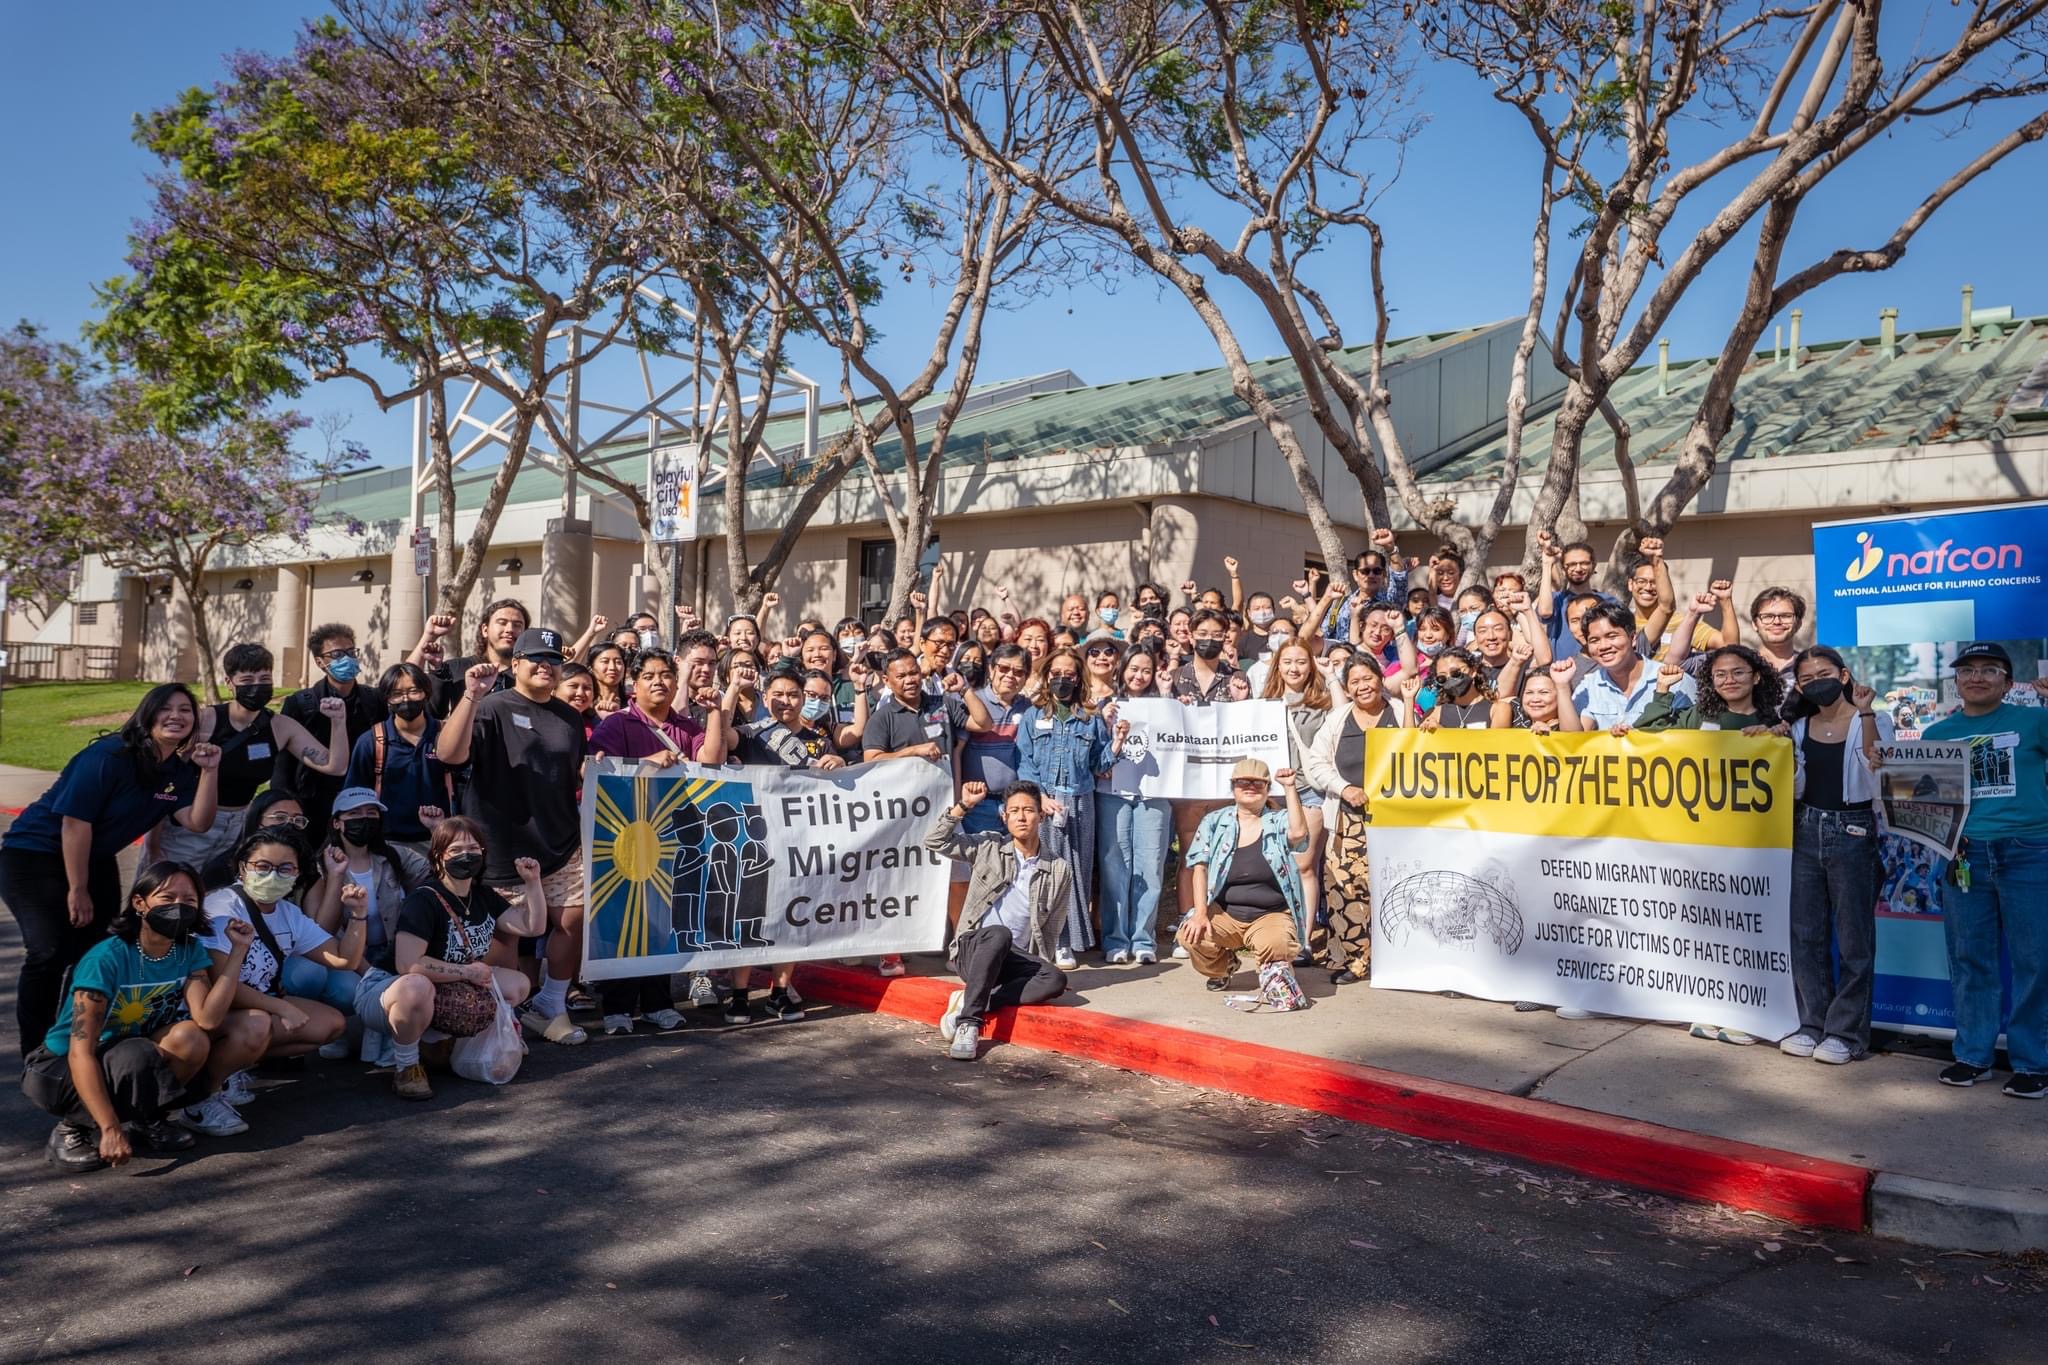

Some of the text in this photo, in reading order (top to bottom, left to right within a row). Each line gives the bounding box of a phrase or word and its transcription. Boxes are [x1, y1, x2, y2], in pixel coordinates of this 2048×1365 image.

[655, 466, 694, 487] playful
[656, 486, 681, 506] city
[662, 505, 678, 516] usa
[1887, 539, 2023, 577] nafcon
[1834, 575, 2041, 597] NATIONAL ALLIANCE FOR FILIPINO CONCERNS
[1156, 732, 1279, 745] Kabataan Alliance
[1380, 751, 1773, 822] JUSTICE FOR THE ROQUES
[781, 790, 931, 832] Filipino
[788, 844, 942, 882] Migrant
[1541, 859, 1770, 897] DEFEND MIGRANT WORKERS NOW!
[785, 893, 919, 927] Center
[1553, 892, 1763, 933] ORGANIZE TO STOP ASIAN HATE
[1534, 922, 1790, 974] JUSTICE FOR VICTIMS OF HATE CRIMES!
[1556, 958, 1767, 1008] SERVICES FOR SURVIVORS NOW!
